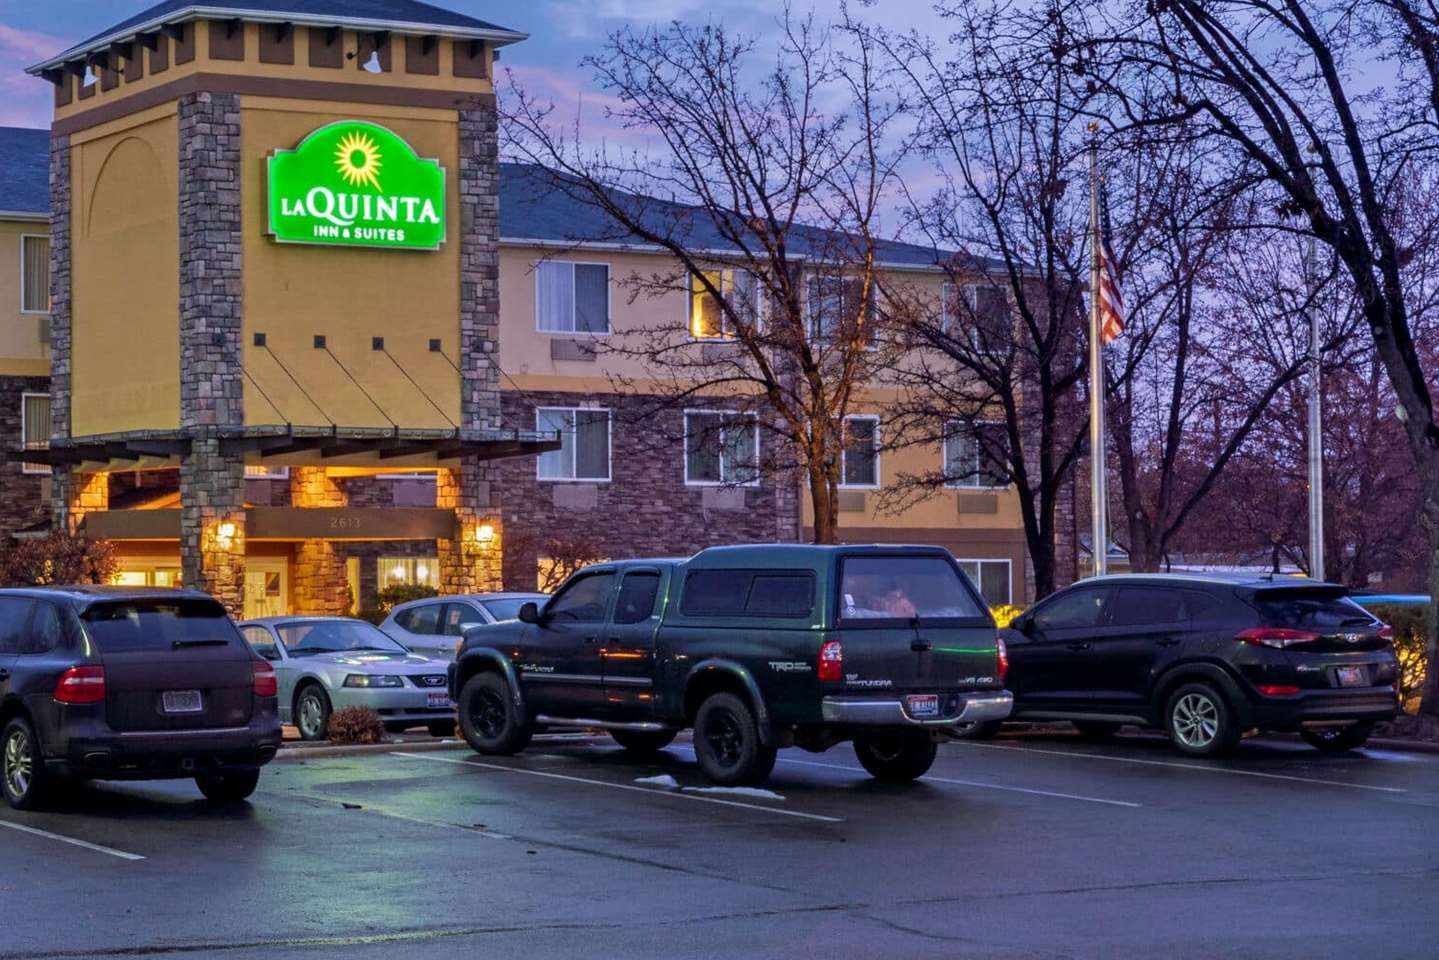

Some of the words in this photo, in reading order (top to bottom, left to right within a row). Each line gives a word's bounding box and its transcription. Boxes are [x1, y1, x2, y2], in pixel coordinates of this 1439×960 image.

[280, 197, 306, 217] LA
[306, 186, 441, 226] QUINTA
[313, 224, 339, 238] INN
[342, 227, 351, 239] &
[354, 226, 405, 241] SUITES
